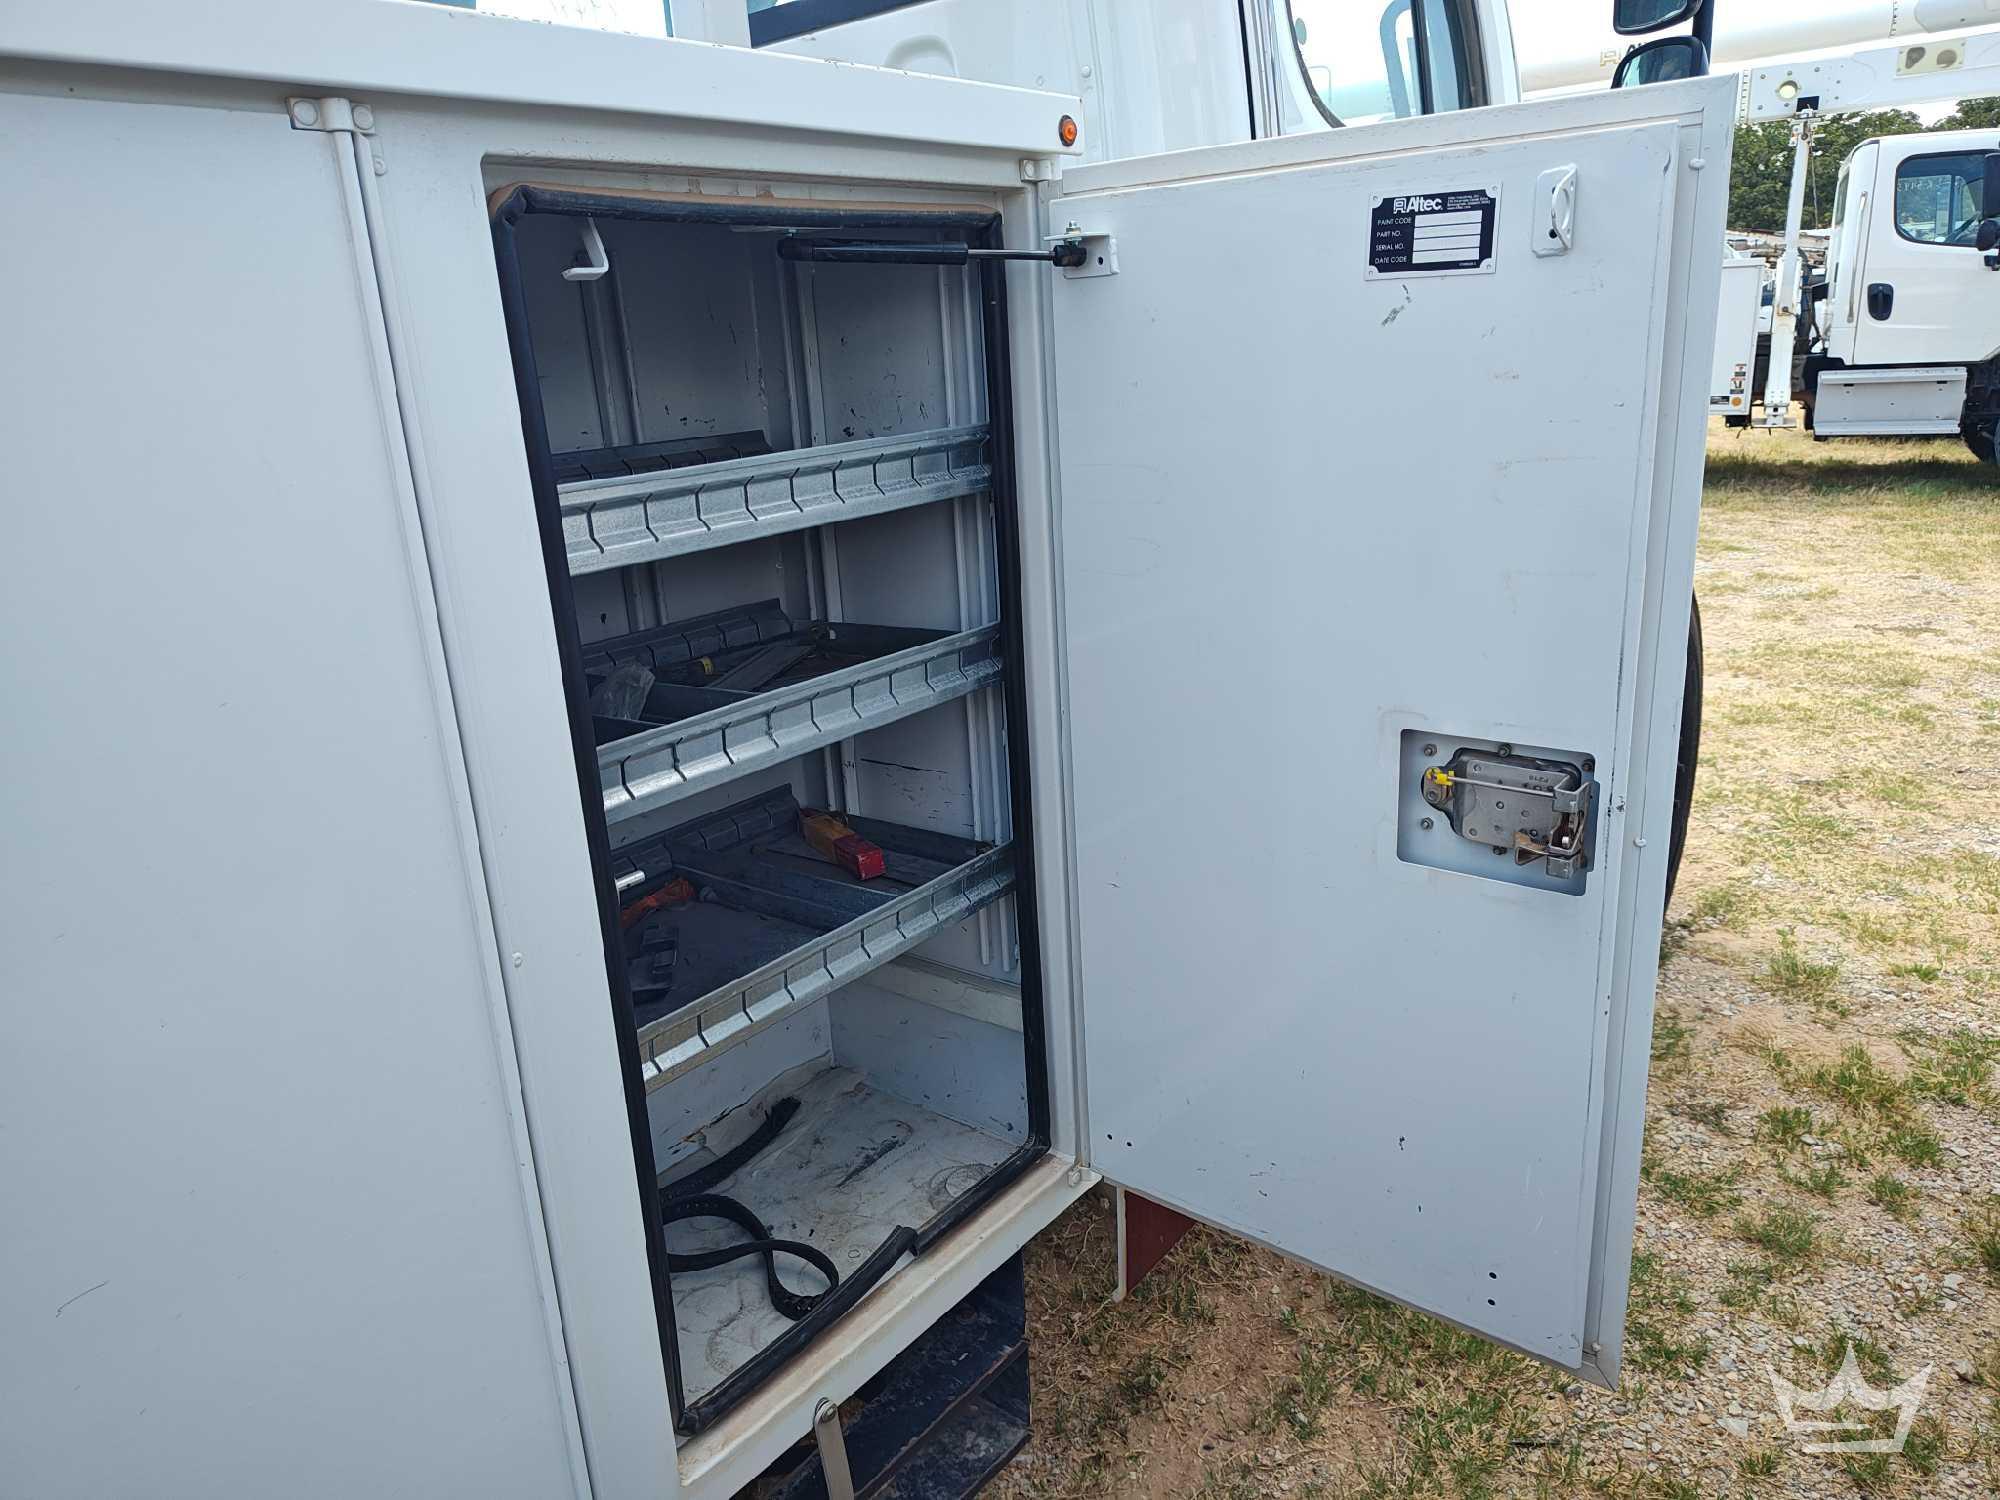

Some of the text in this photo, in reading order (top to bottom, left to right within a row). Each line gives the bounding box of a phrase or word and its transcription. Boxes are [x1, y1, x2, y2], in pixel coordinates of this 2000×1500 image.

[1406, 196, 1443, 213] Altec
[1377, 217, 1412, 226] PAINT CODE
[1376, 230, 1391, 238] PART
[1375, 244, 1393, 252] SERIAL
